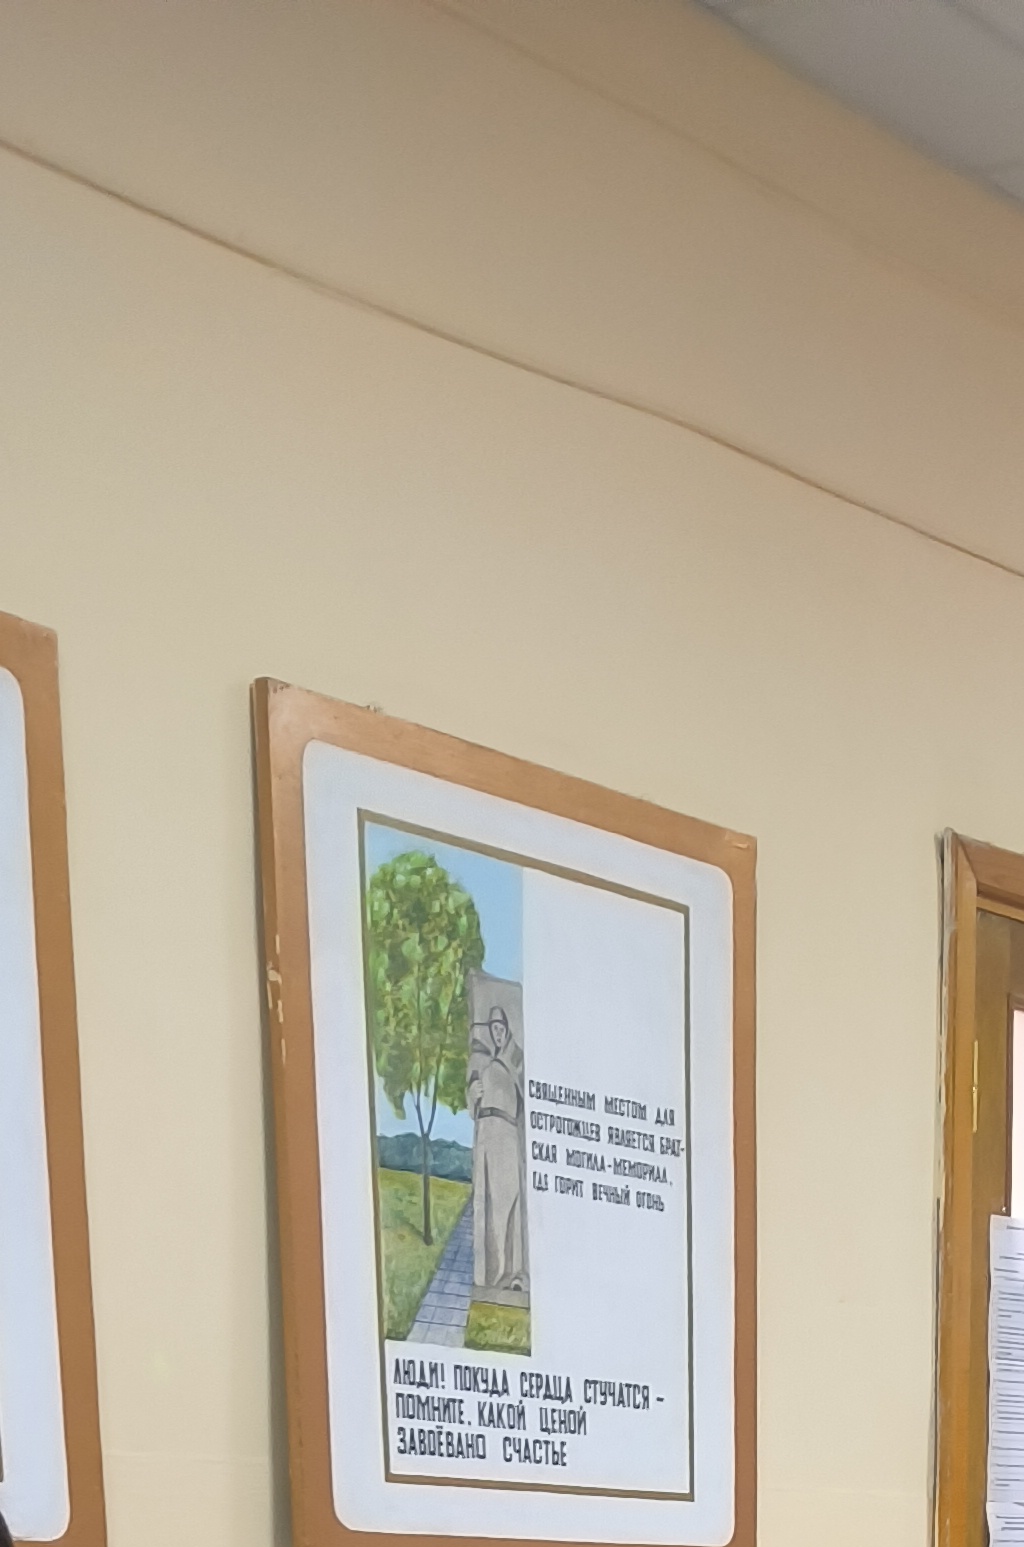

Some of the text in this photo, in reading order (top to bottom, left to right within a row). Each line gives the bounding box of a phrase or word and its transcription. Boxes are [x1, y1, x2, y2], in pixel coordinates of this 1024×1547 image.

[528, 1079, 675, 1126] СВЯЩЕННЫМ МЕСТОМ ДЛЯ
[530, 1110, 601, 1142] ОСТРОГОЖЦЕВ
[607, 1126, 655, 1153] ЯВЛЯЕТСЯ
[531, 1141, 558, 1163] СКАЯ
[532, 1171, 665, 1212] ГДЕ ГОРИТ ВЕЧНЫЙ ОГОНЬ
[393, 1358, 446, 1390] ЛЮДИ!
[453, 1364, 510, 1397] ПОКУДА
[519, 1371, 573, 1404] СЕРДЦА
[583, 1379, 650, 1410] СТУЧАТСЯ
[478, 1400, 527, 1431] КАКОЙ
[539, 1405, 588, 1436] ЦЕНОЙ
[397, 1424, 568, 1467] ЗАВОЁВАНО СЧАСТЬЕ
